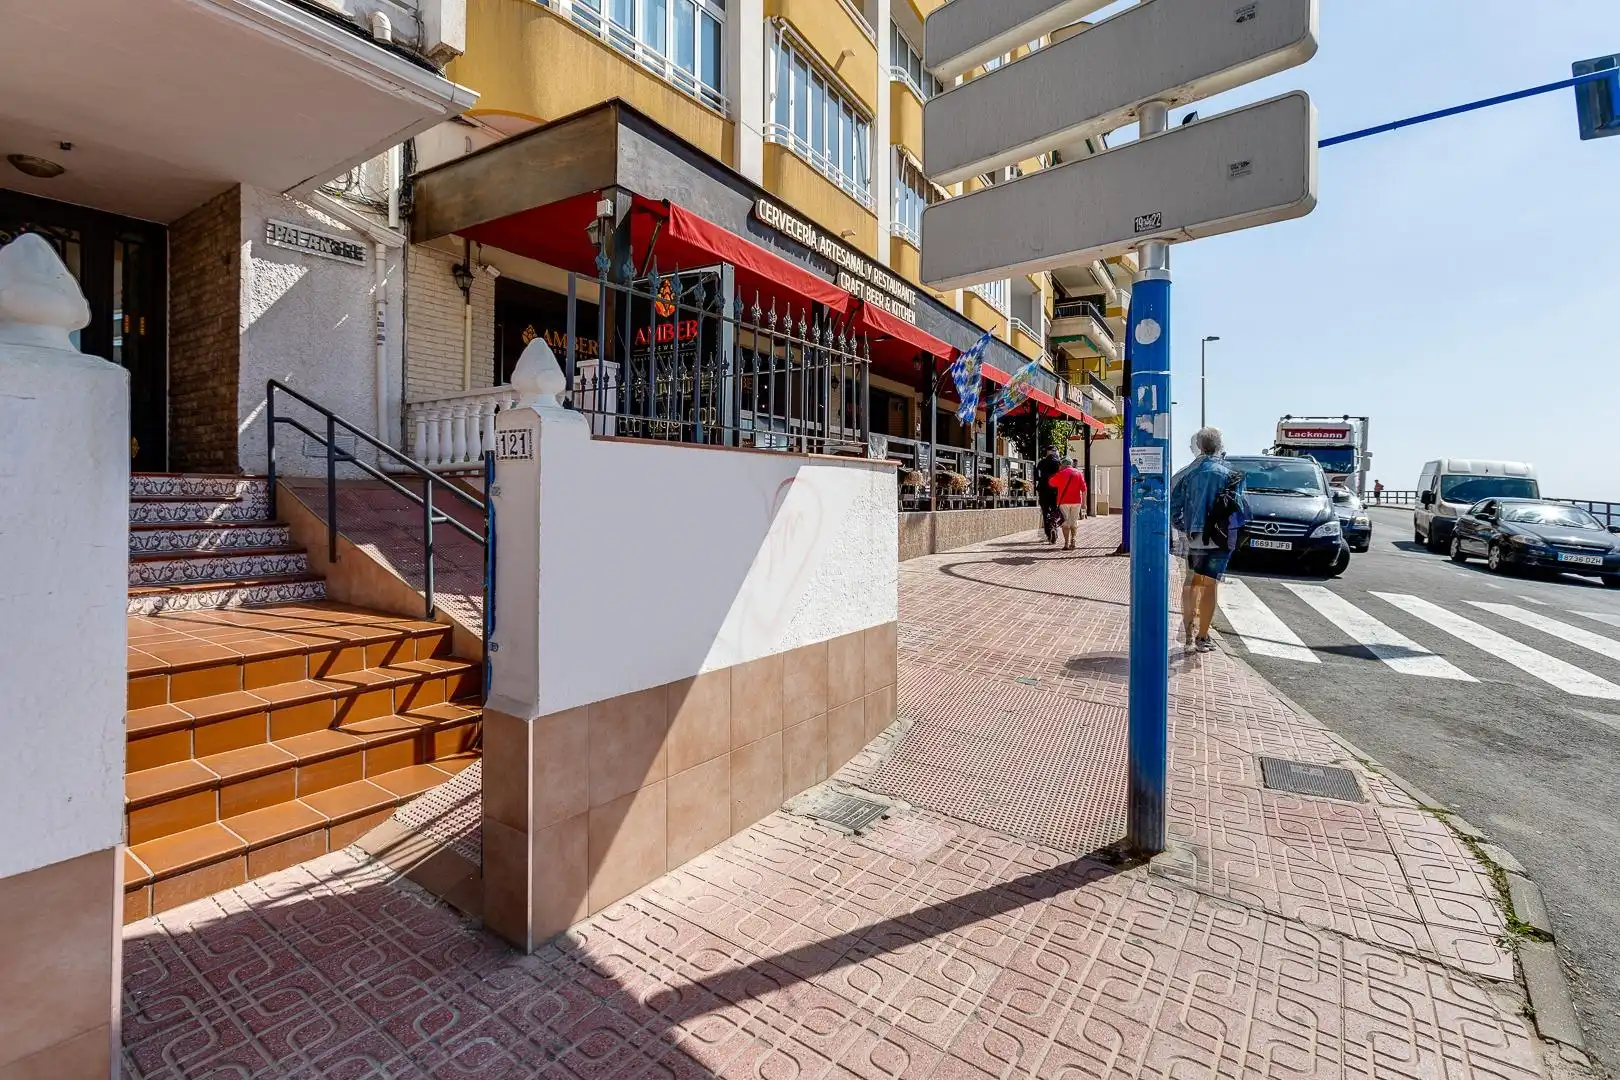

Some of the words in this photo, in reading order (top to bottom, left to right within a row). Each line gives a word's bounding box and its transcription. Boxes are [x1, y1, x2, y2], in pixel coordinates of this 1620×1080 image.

[758, 199, 818, 251] CERVECERÍA
[819, 236, 866, 278] ARTESANAL
[866, 263, 873, 281] Y
[874, 267, 917, 307] RESTAURANTE
[839, 271, 865, 299] CRAFT
[866, 288, 884, 309] BEER
[884, 299, 891, 313] &
[891, 299, 916, 326] KITCHEN
[634, 320, 698, 346] AMBER
[500, 433, 526, 456] 121
[1288, 431, 1343, 439] Lackmann
